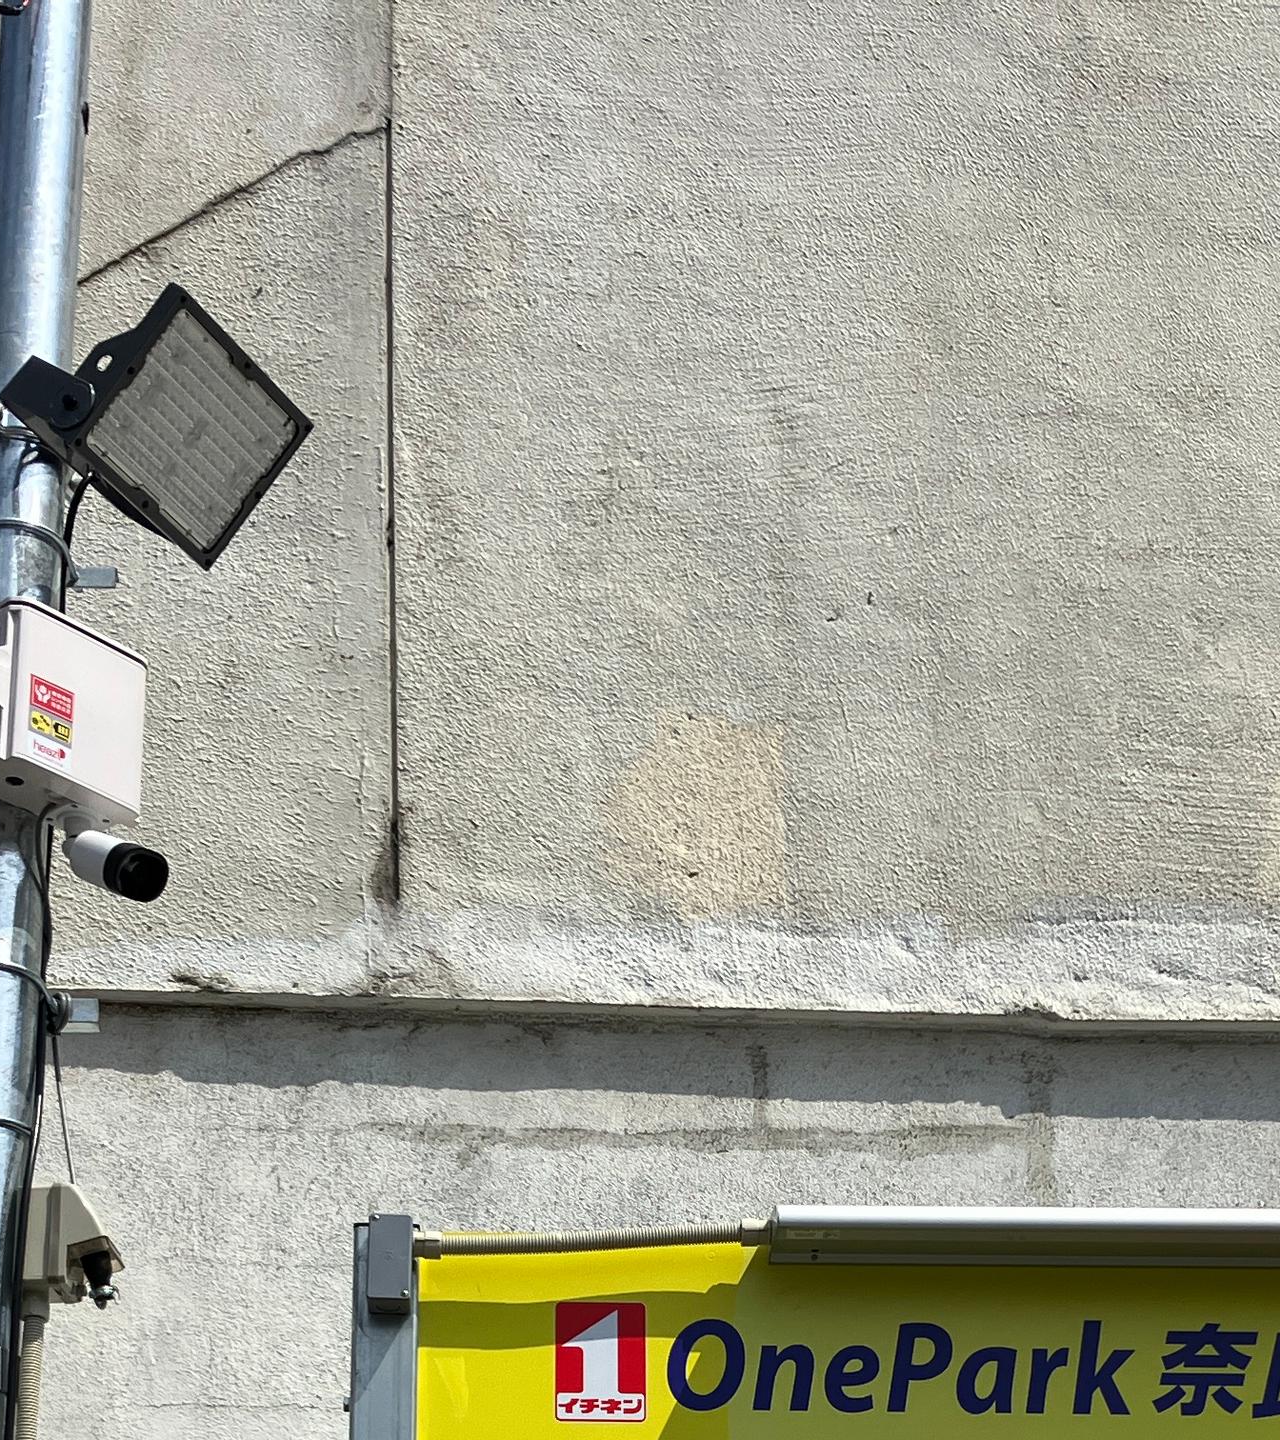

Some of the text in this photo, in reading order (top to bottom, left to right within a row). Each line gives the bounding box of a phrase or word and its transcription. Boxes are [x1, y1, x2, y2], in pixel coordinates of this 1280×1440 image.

[666, 1319, 1136, 1414] OnePark
[557, 1395, 645, 1417] イチネン
